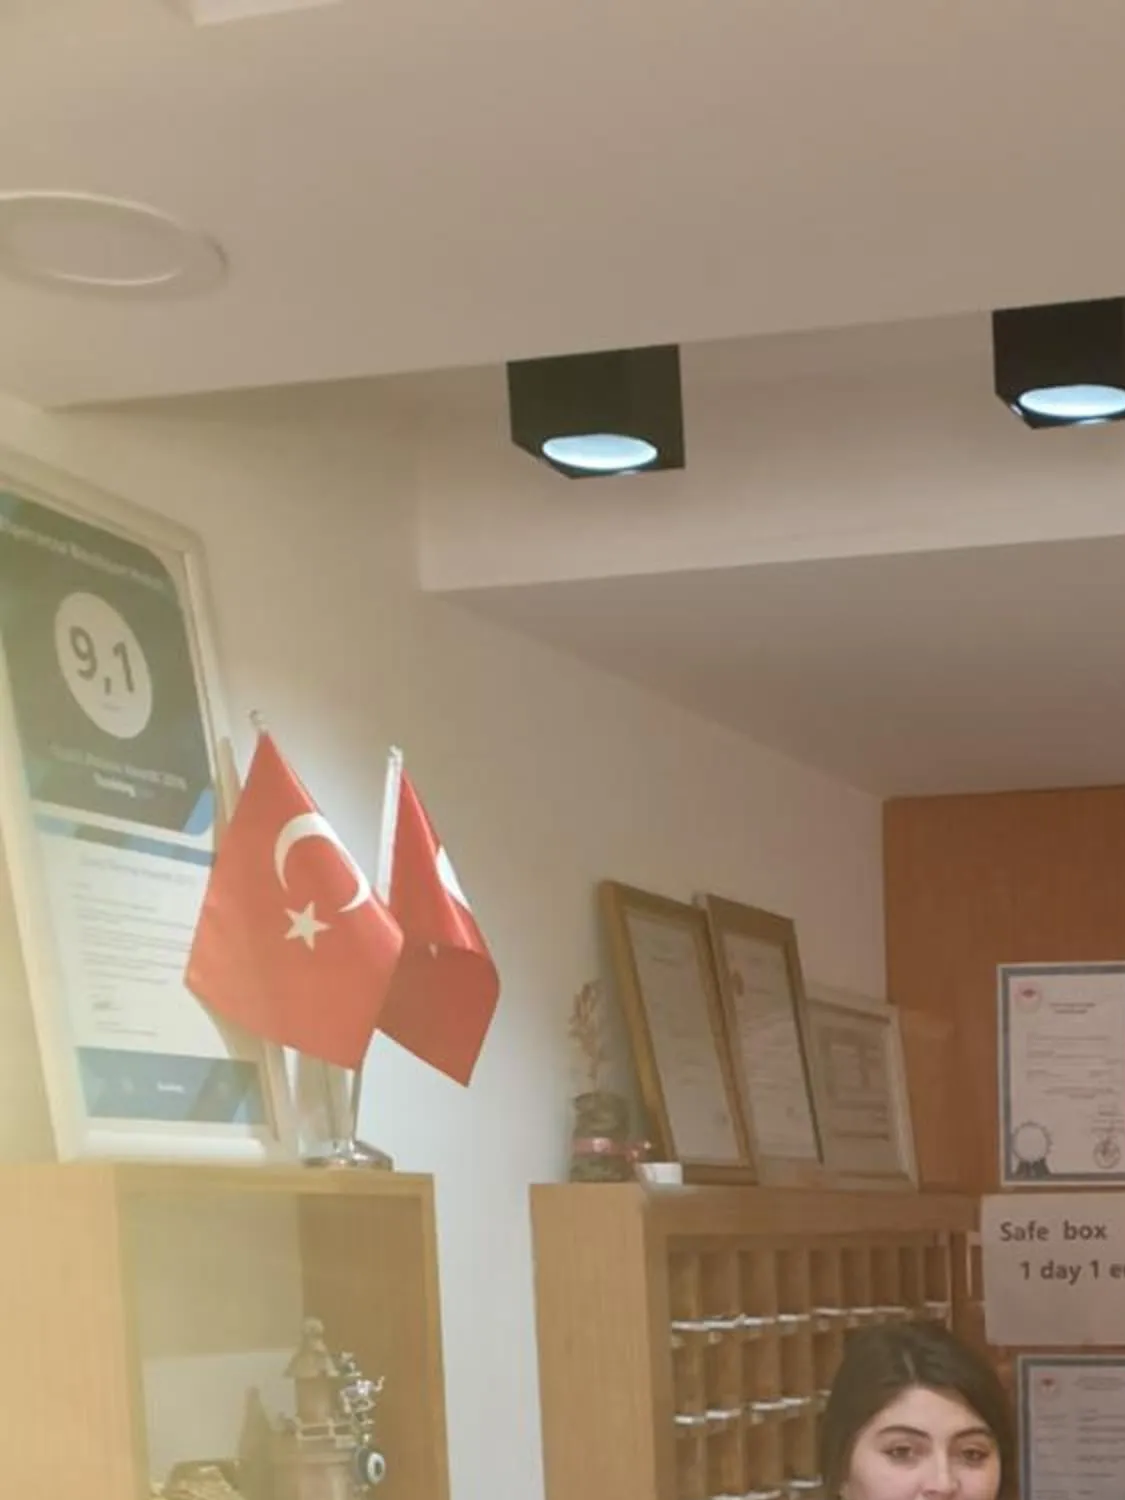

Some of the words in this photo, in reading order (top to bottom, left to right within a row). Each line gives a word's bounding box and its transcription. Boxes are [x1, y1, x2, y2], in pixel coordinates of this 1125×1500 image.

[68, 624, 135, 697] 9,1
[1000, 1220, 1050, 1242] Safe
[1063, 1219, 1108, 1240] box
[1020, 1260, 1031, 1280] 1
[1040, 1260, 1083, 1286] day
[1090, 1259, 1100, 1279] 1
